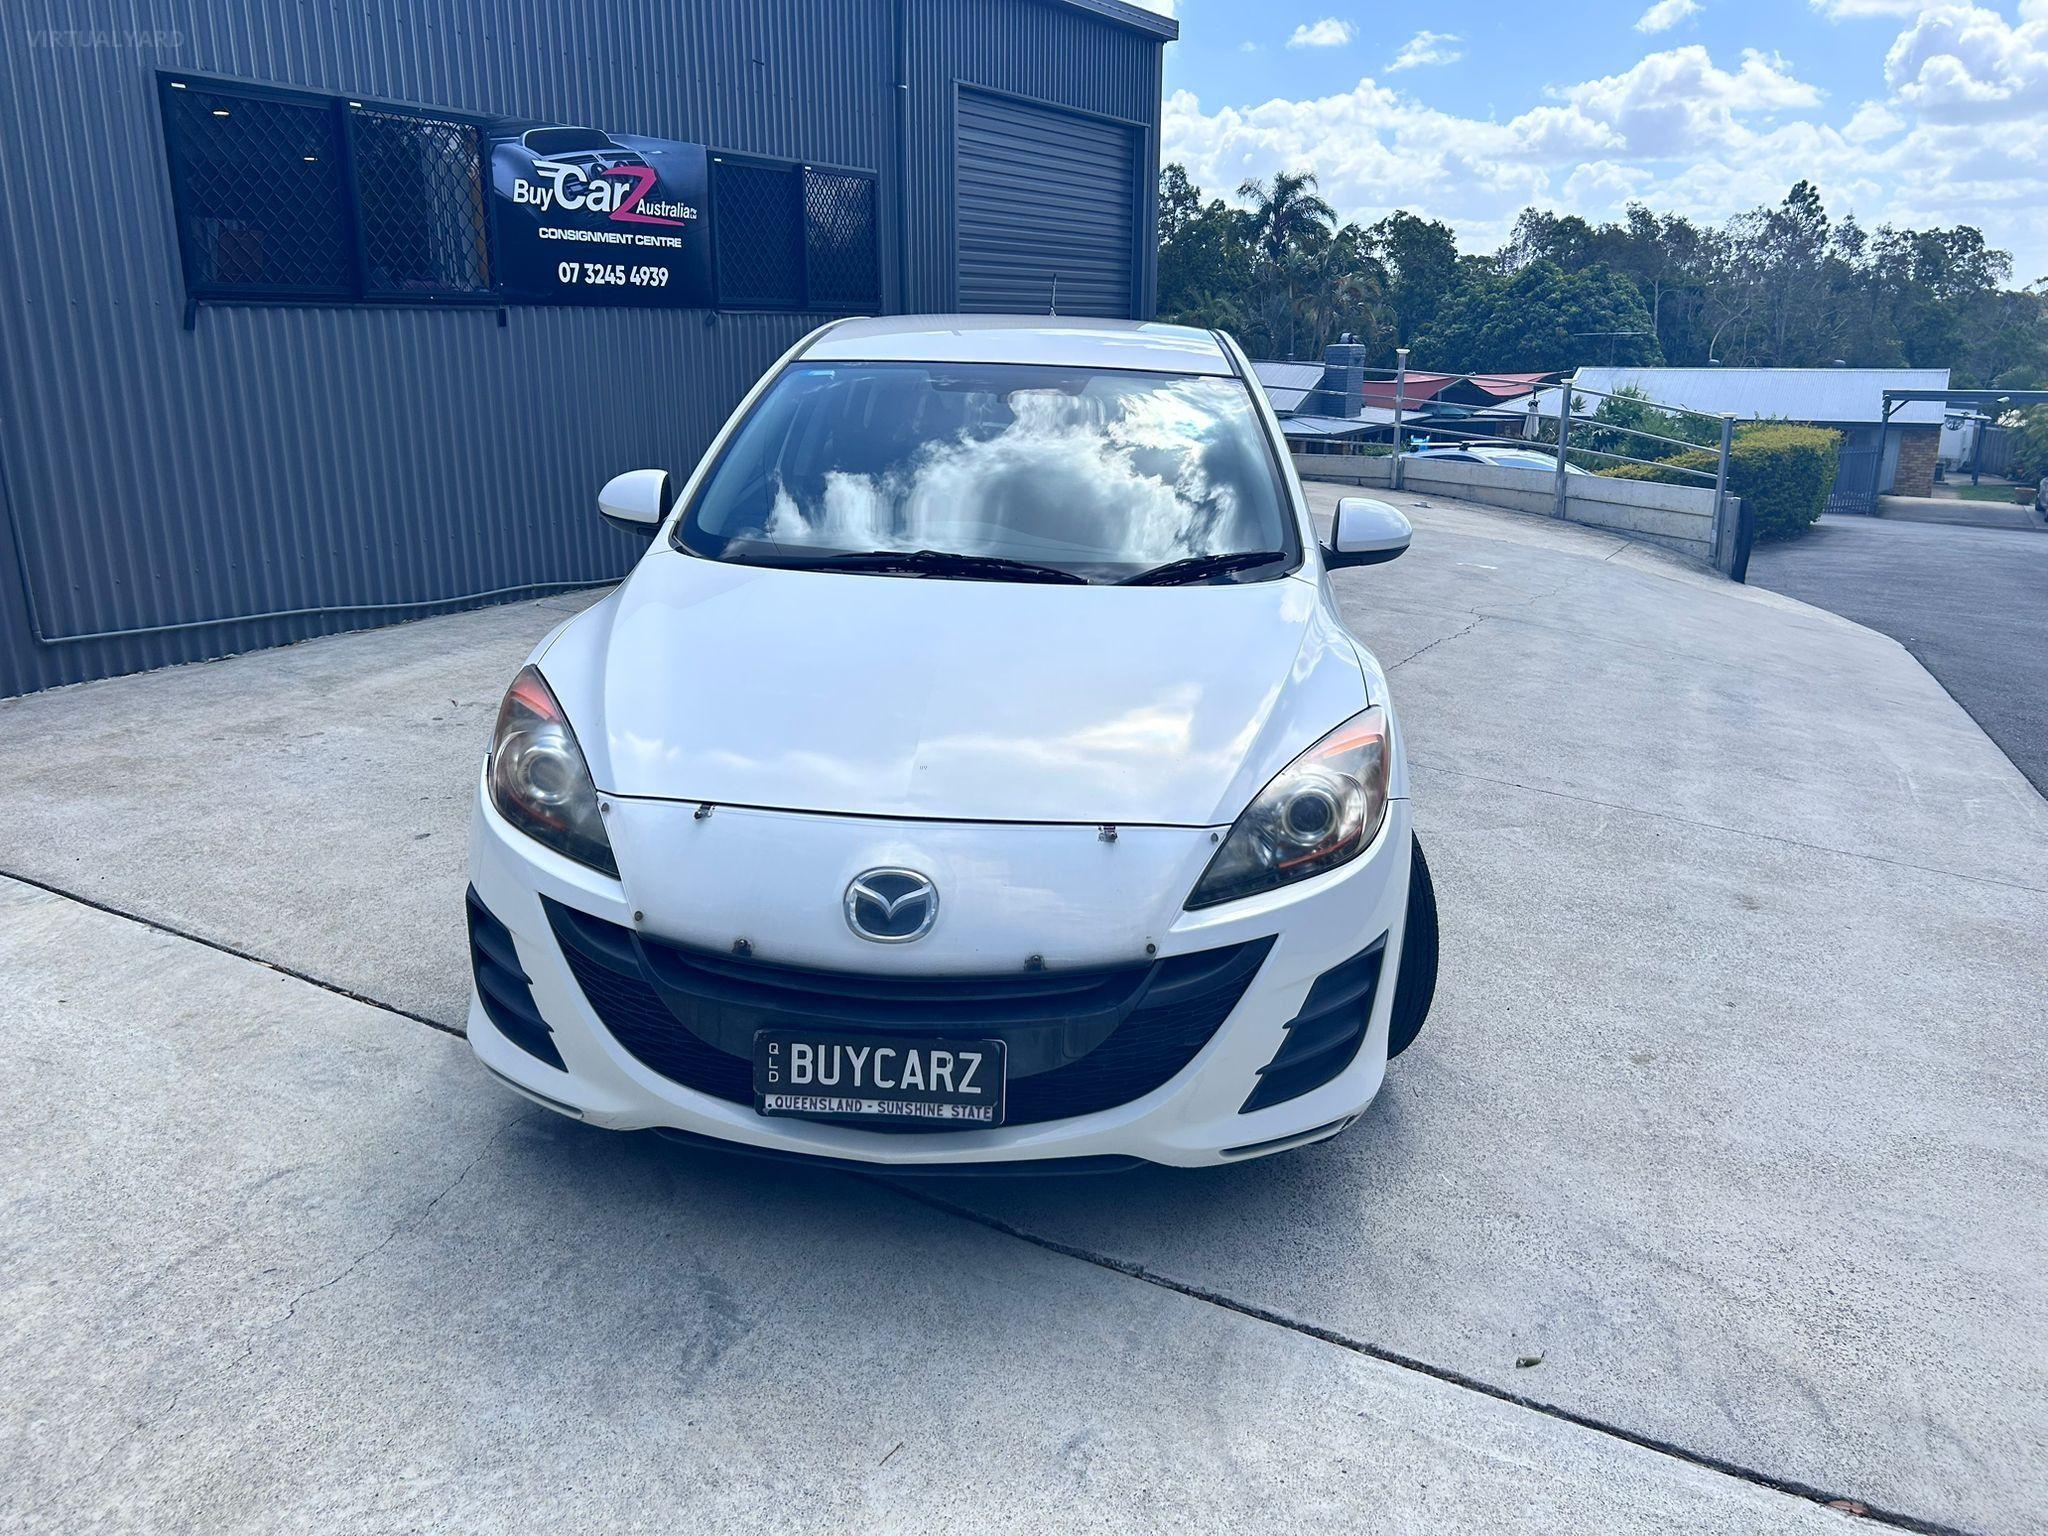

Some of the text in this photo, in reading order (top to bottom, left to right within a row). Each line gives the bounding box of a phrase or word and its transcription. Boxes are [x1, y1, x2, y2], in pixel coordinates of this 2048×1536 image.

[635, 199, 690, 219] Australia
[538, 227, 682, 248] CONSIGNMENT CENTRE
[558, 262, 669, 287] 07 3245 4939
[790, 1043, 983, 1095] BUYCARZ
[774, 1096, 863, 1113] QUEENSLAND
[877, 1101, 944, 1117] SUNSHINE
[951, 1105, 992, 1120] STATE
